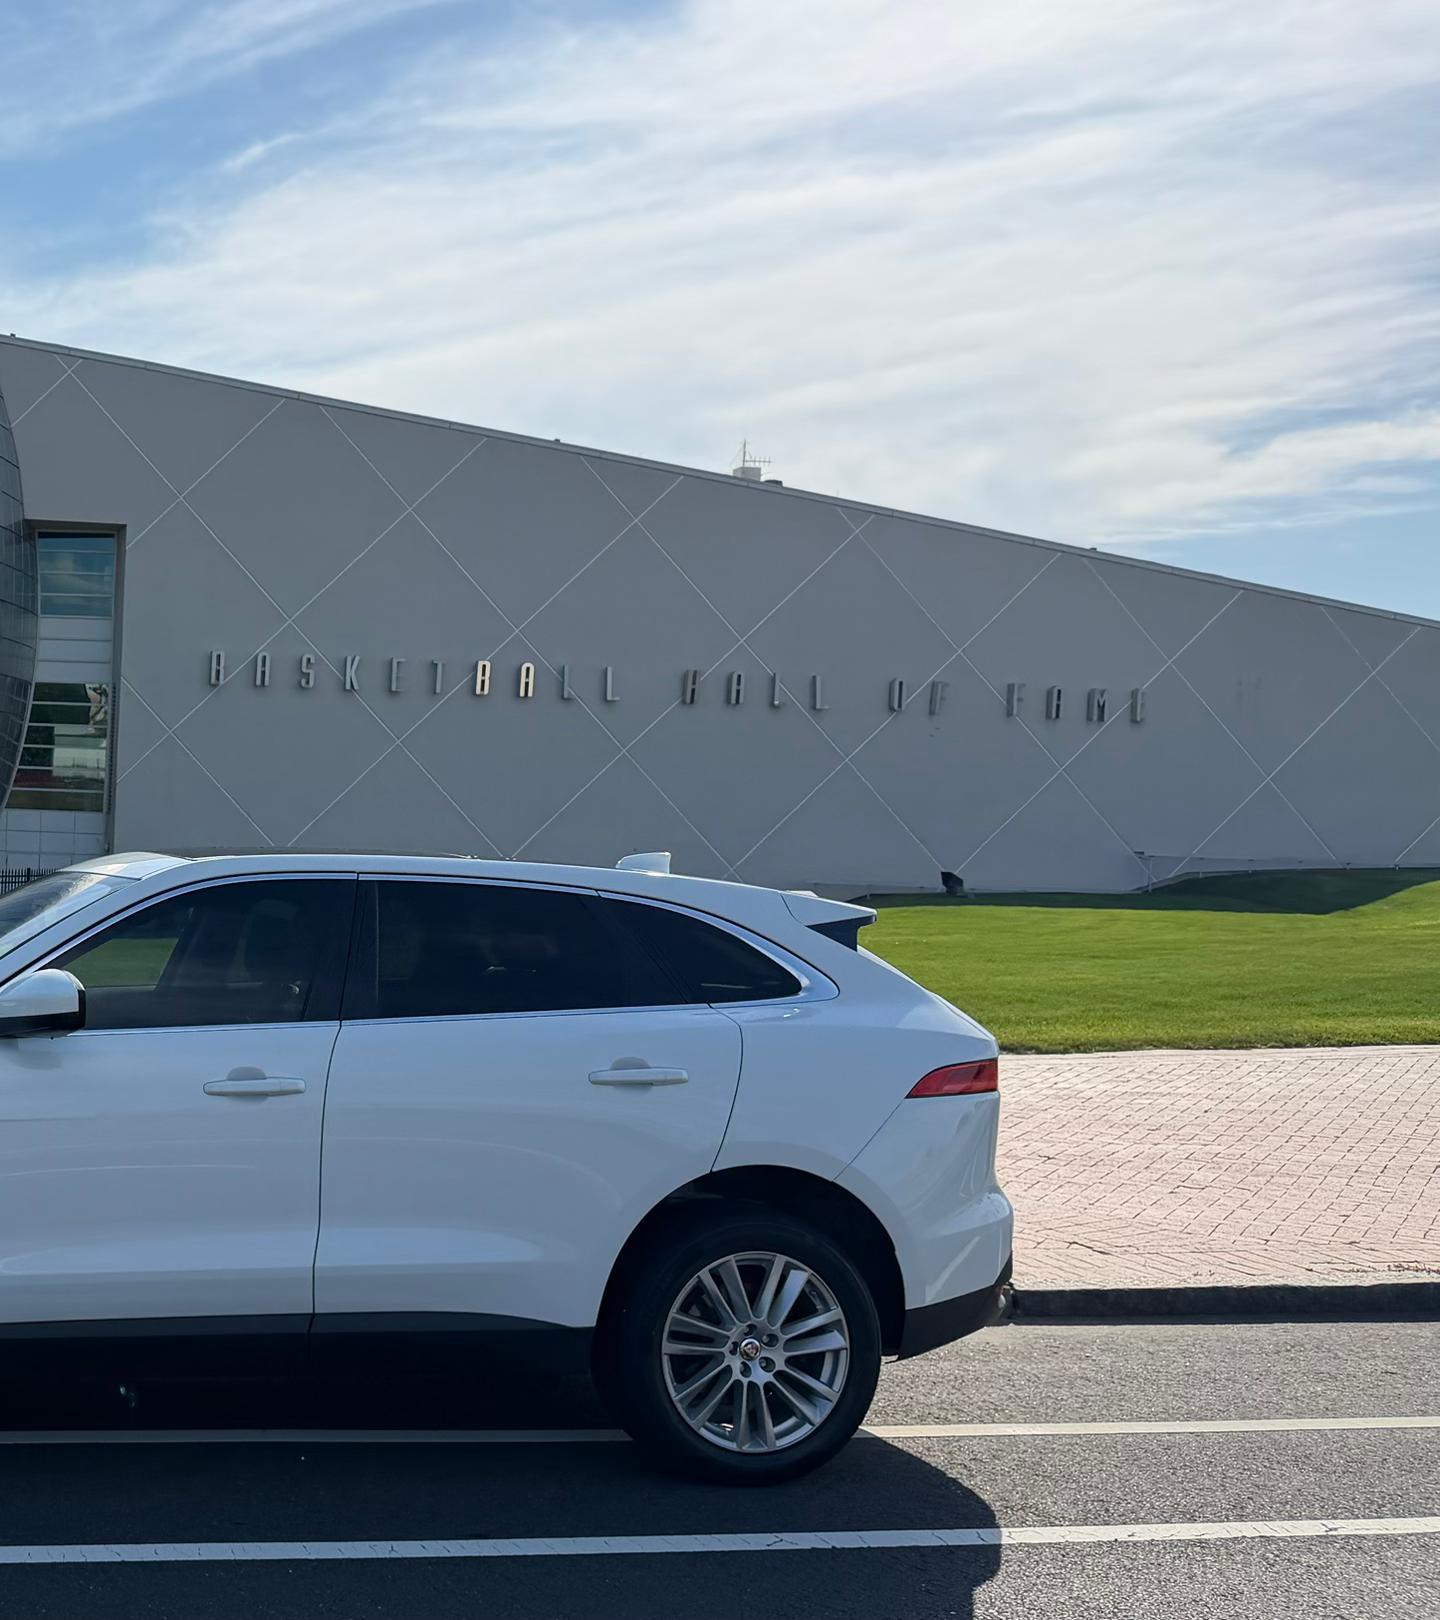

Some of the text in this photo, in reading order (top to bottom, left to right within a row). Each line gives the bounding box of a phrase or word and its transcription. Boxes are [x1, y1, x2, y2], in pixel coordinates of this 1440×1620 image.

[209, 650, 1146, 723] BASKETBALL HALL OF FAME
